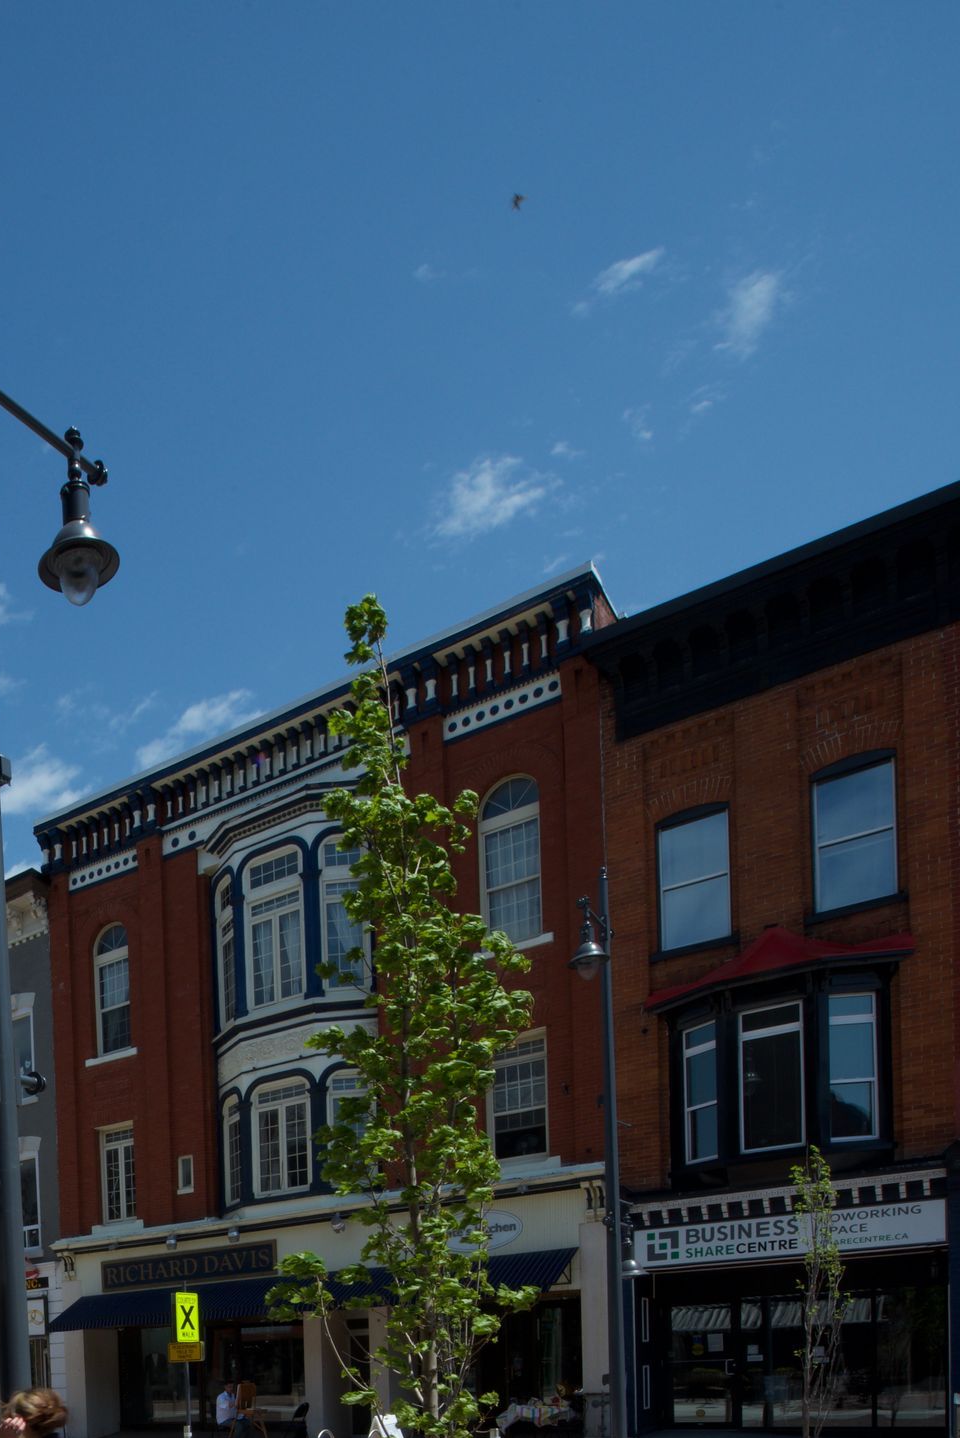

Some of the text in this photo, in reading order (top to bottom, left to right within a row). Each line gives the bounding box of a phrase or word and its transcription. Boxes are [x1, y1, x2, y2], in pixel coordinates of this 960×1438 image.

[829, 1204, 922, 1223] OWORKING
[475, 1223, 517, 1235] Kchen
[685, 1217, 799, 1245] BUSINESS
[827, 1222, 868, 1235] PACE
[685, 1238, 798, 1259] SHARECENTRE
[828, 1232, 909, 1246] ARECENTRE.CA
[106, 1248, 271, 1287] RICHARD DAVIS
